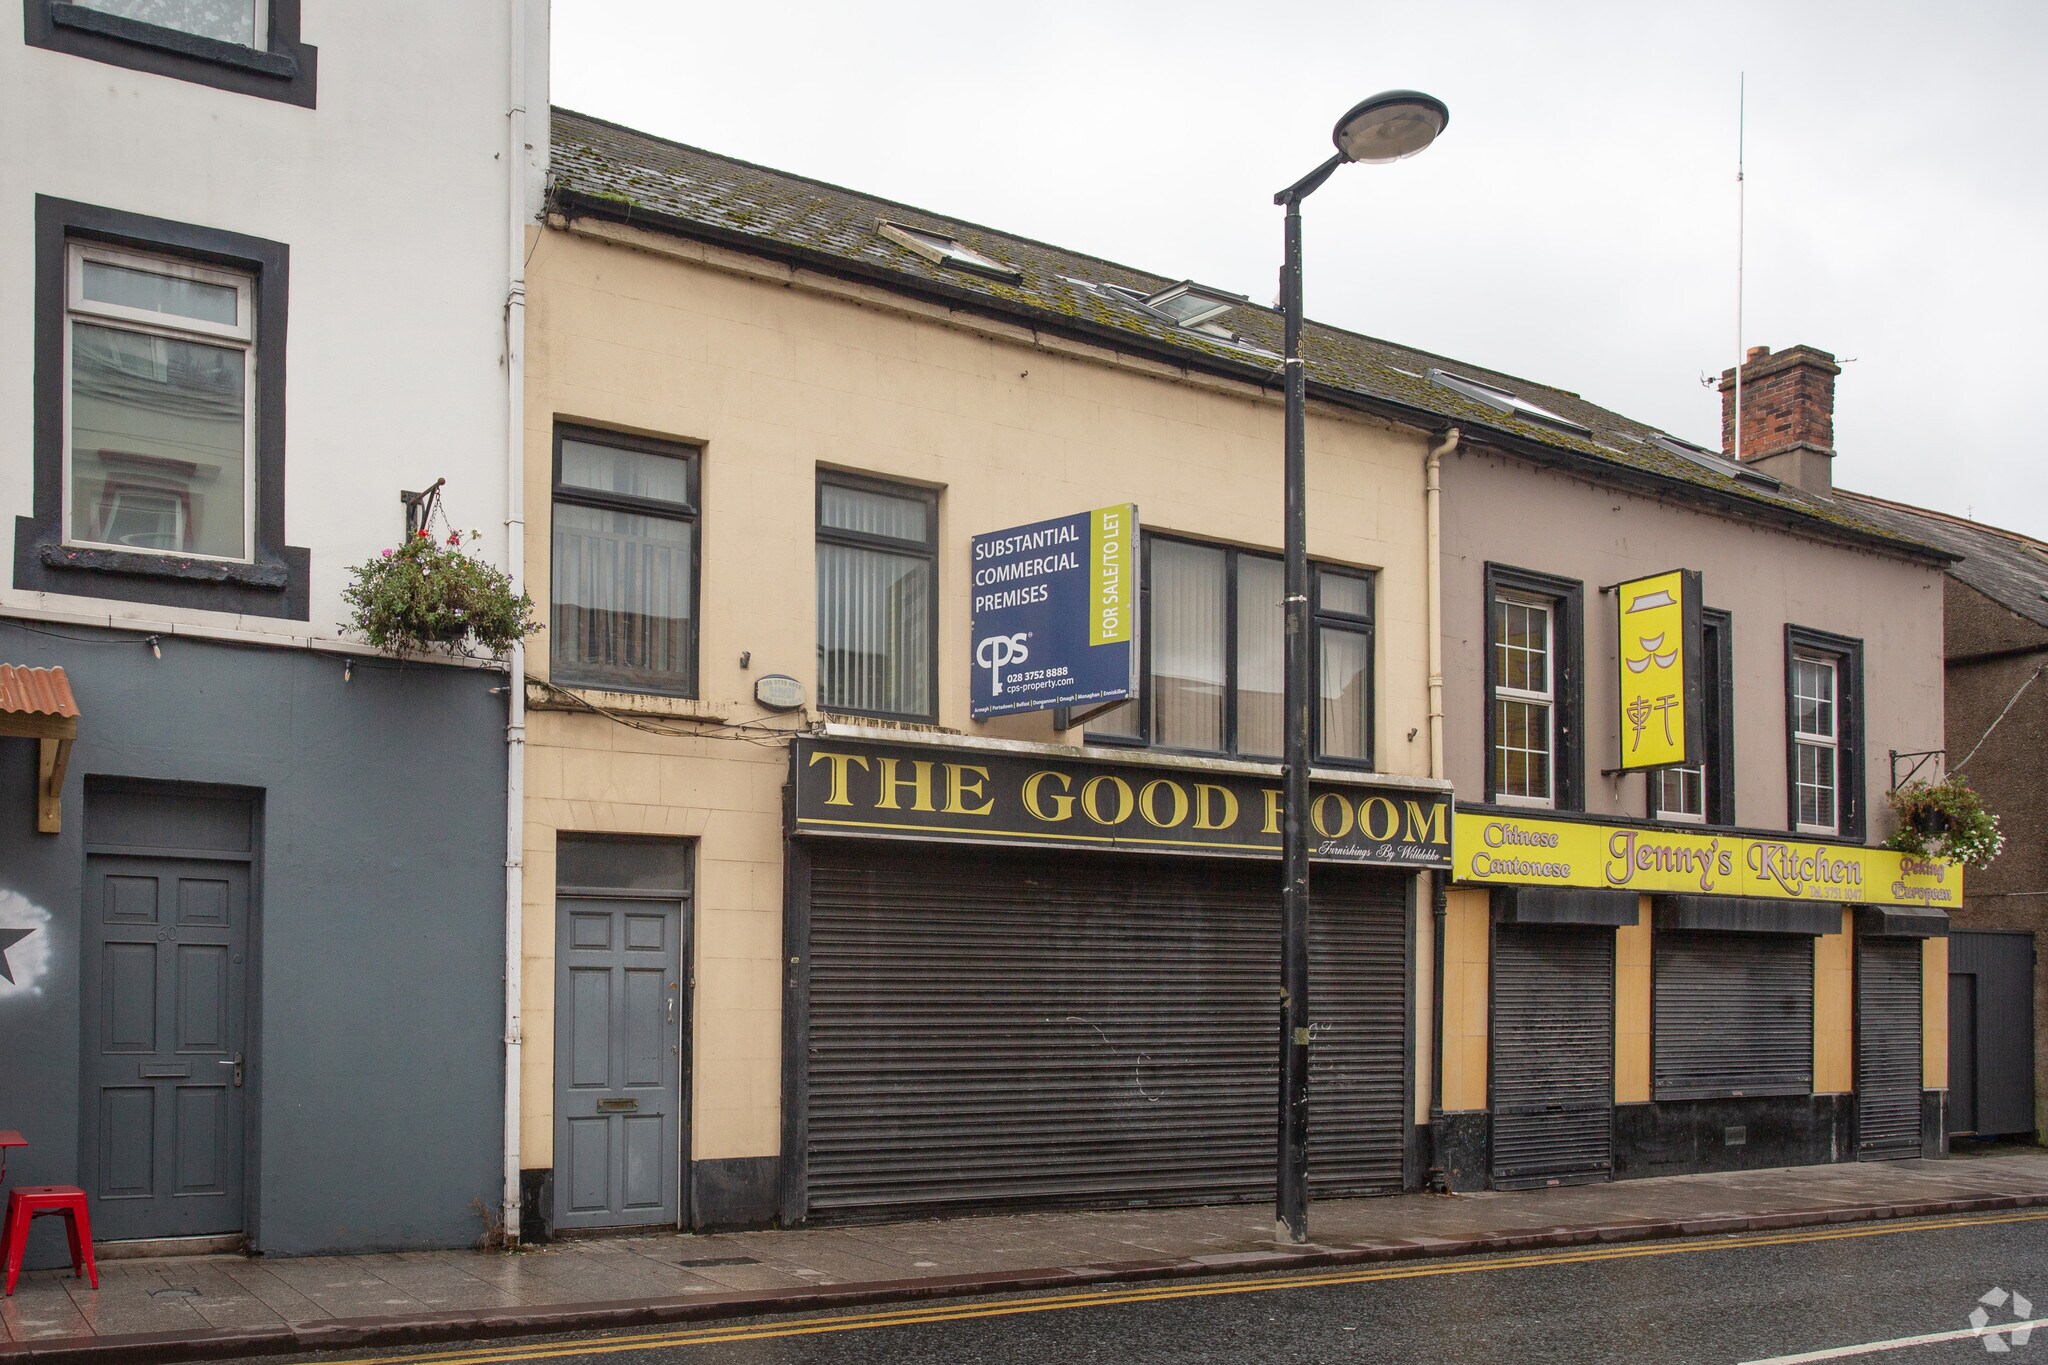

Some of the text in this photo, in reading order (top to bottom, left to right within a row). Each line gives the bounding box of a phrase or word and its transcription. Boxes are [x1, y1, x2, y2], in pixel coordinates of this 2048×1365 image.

[975, 524, 1079, 560] SUBSTANTIAL
[975, 552, 1079, 586] COMMERCIAL
[1102, 513, 1119, 638] FOR SALE/TO LET
[975, 584, 1048, 613] PREMISES
[1006, 666, 1068, 683] 028 3752 8888
[1006, 677, 1074, 694] cps-property.com
[809, 751, 995, 816] THE
[1021, 770, 1239, 830] GOOD
[1483, 822, 1559, 848] Chinese
[1318, 840, 1372, 860] Furnishings
[1375, 843, 1396, 862] By
[1471, 851, 1571, 878] Cantonese
[1605, 830, 1863, 896] Jenny's Kitchen
[1899, 856, 1945, 884] Peking
[1891, 878, 1952, 907] European
[157, 925, 177, 942] 60
